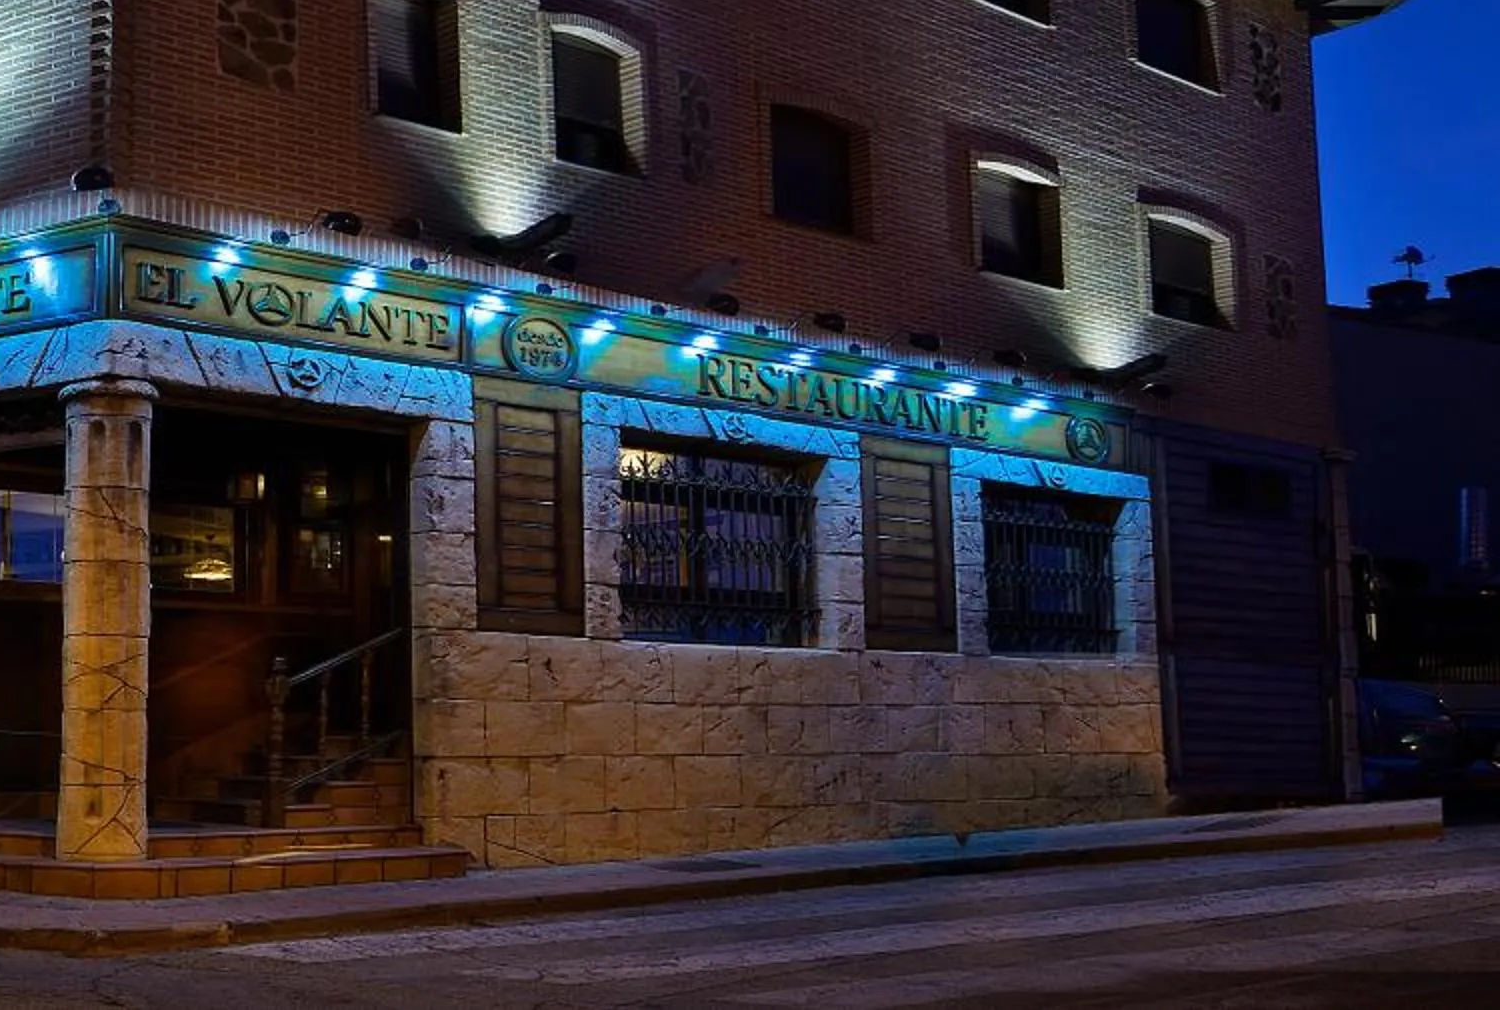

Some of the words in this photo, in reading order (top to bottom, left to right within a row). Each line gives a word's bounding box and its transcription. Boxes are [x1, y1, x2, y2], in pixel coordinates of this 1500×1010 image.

[137, 262, 196, 308] EL
[213, 275, 450, 350] VOLANTE
[517, 328, 564, 348] desde
[695, 353, 989, 440] RESTAURANTE
